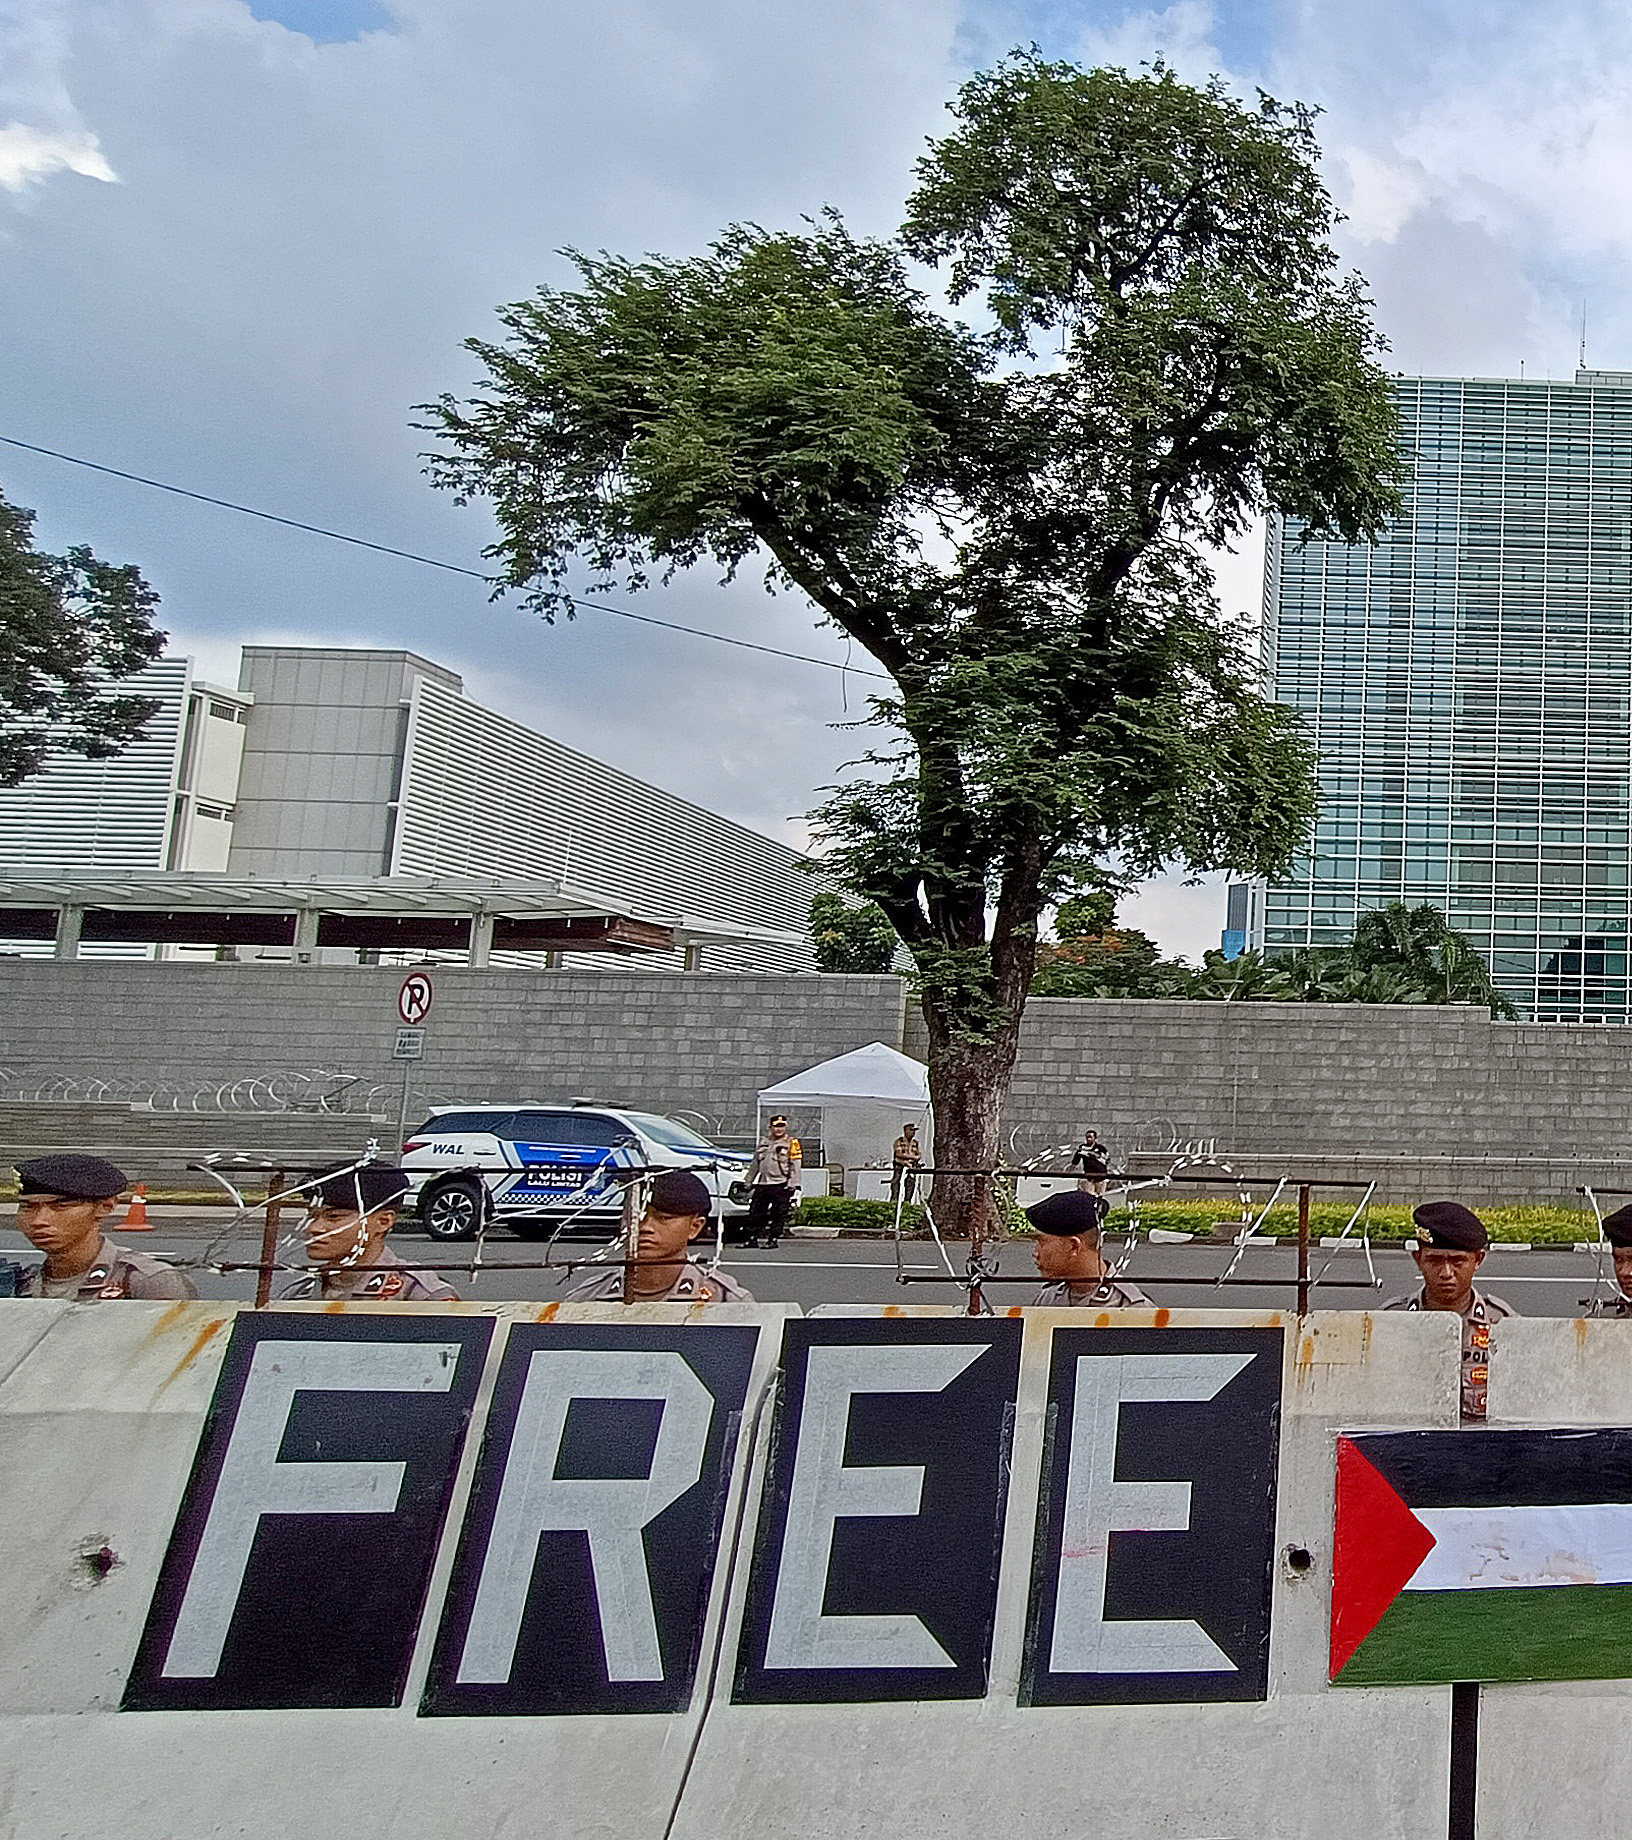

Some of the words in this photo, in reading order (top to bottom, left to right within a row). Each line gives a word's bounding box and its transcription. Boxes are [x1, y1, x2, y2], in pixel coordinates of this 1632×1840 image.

[433, 1143, 465, 1155] WAL
[528, 1164, 582, 1181] POLISI
[160, 1339, 1257, 1684] FREE
